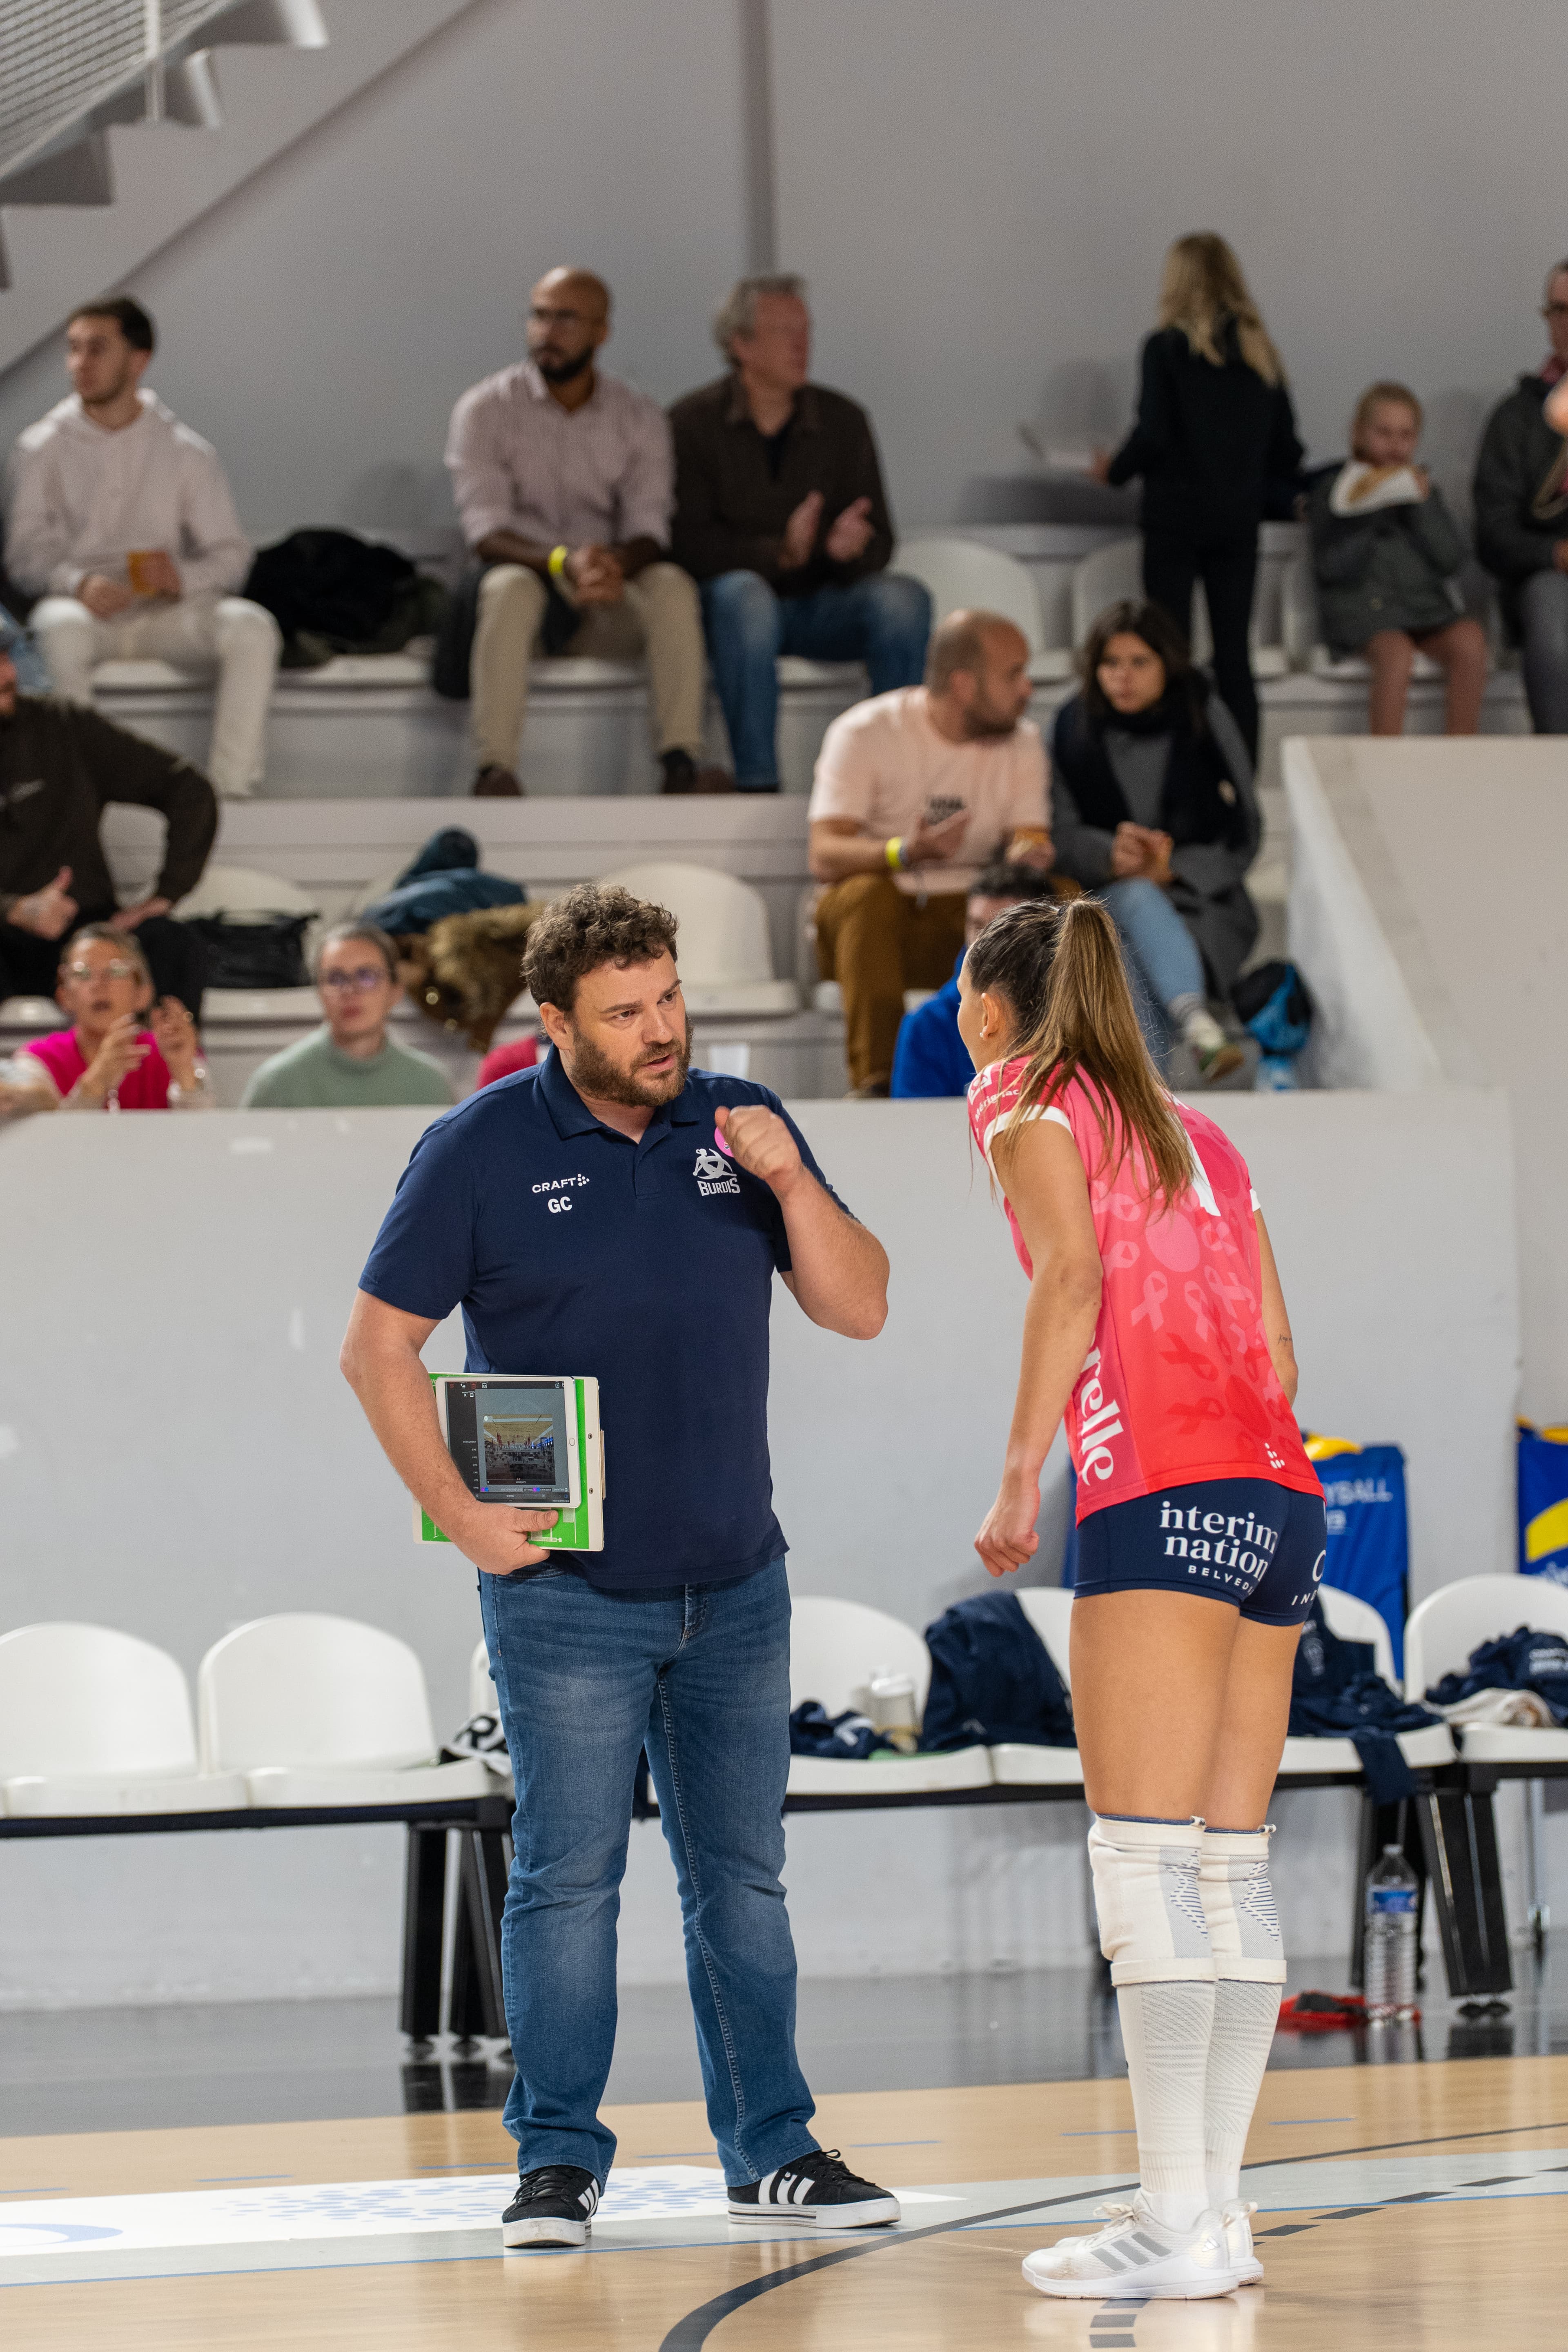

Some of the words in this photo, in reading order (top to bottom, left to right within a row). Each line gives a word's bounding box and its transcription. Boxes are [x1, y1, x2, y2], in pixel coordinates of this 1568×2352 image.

[532, 1177, 576, 1193] CRAFT
[697, 1177, 740, 1196] BURDIS
[548, 1196, 572, 1214] GC
[1080, 1331, 1124, 1486] relle
[1159, 1501, 1278, 1554] interim
[1164, 1536, 1268, 1581] nation
